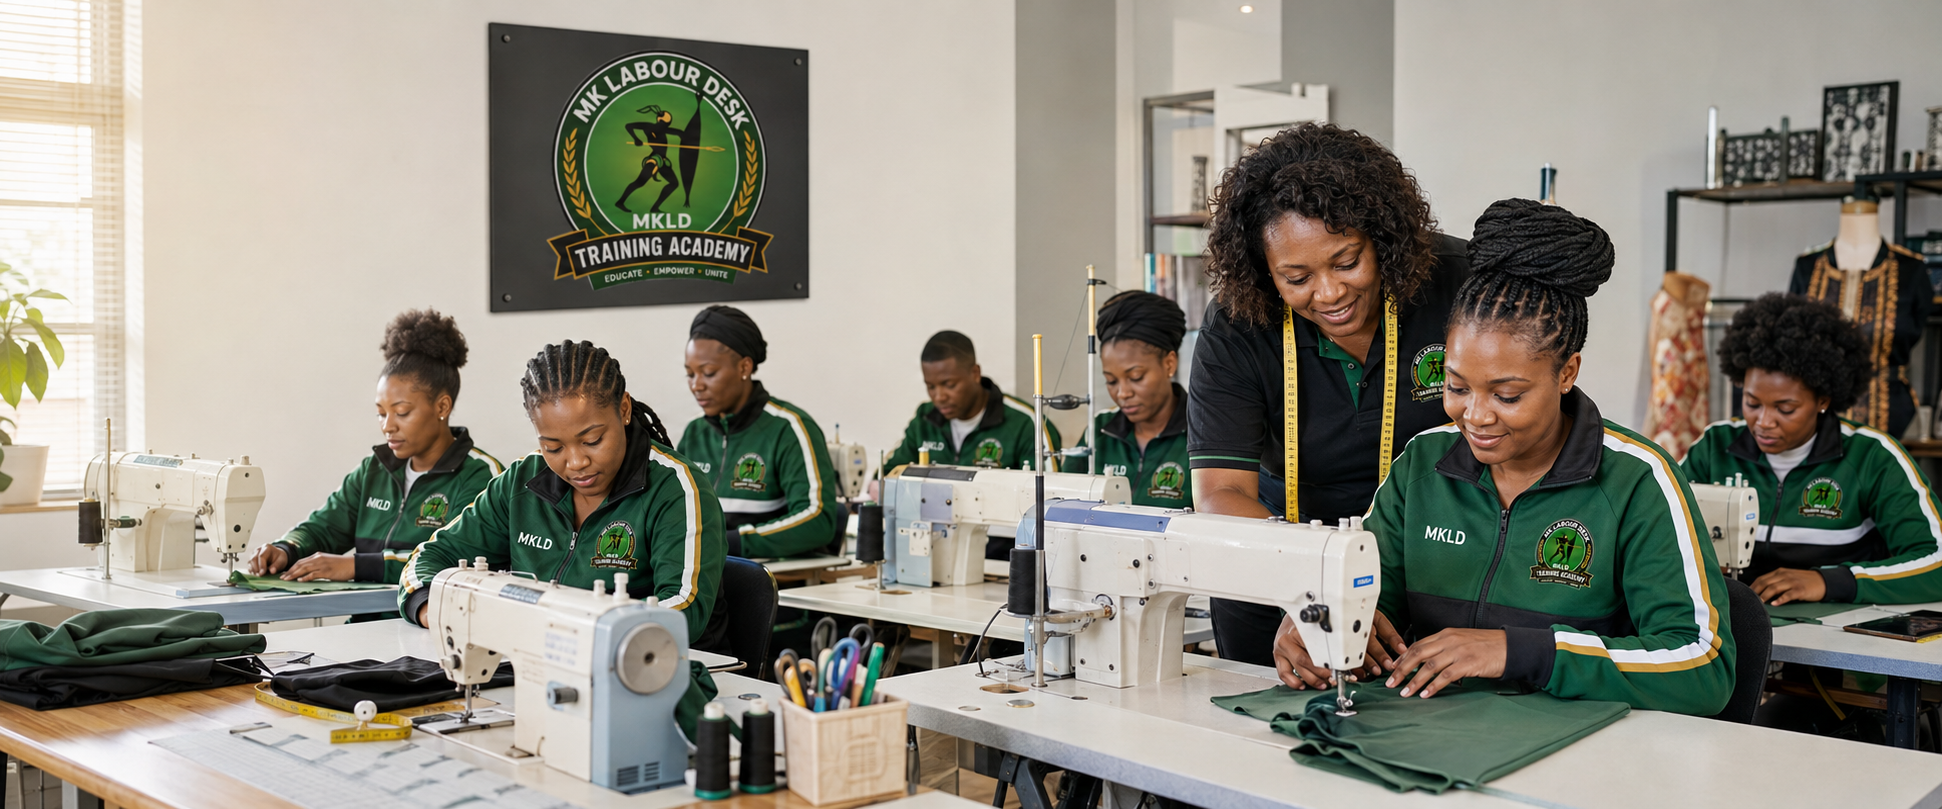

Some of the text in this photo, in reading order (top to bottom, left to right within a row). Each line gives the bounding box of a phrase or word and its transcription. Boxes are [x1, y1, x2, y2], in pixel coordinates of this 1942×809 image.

[573, 59, 750, 130] MK LABOUR DESK
[632, 213, 692, 230] MKLD
[574, 236, 751, 268] TRAINING ACADEMY
[604, 266, 729, 283] EDUCATE EMPOWER UNITE
[366, 496, 391, 511] MKLD
[517, 531, 553, 550] MKLD
[1424, 525, 1466, 545] MKLD
